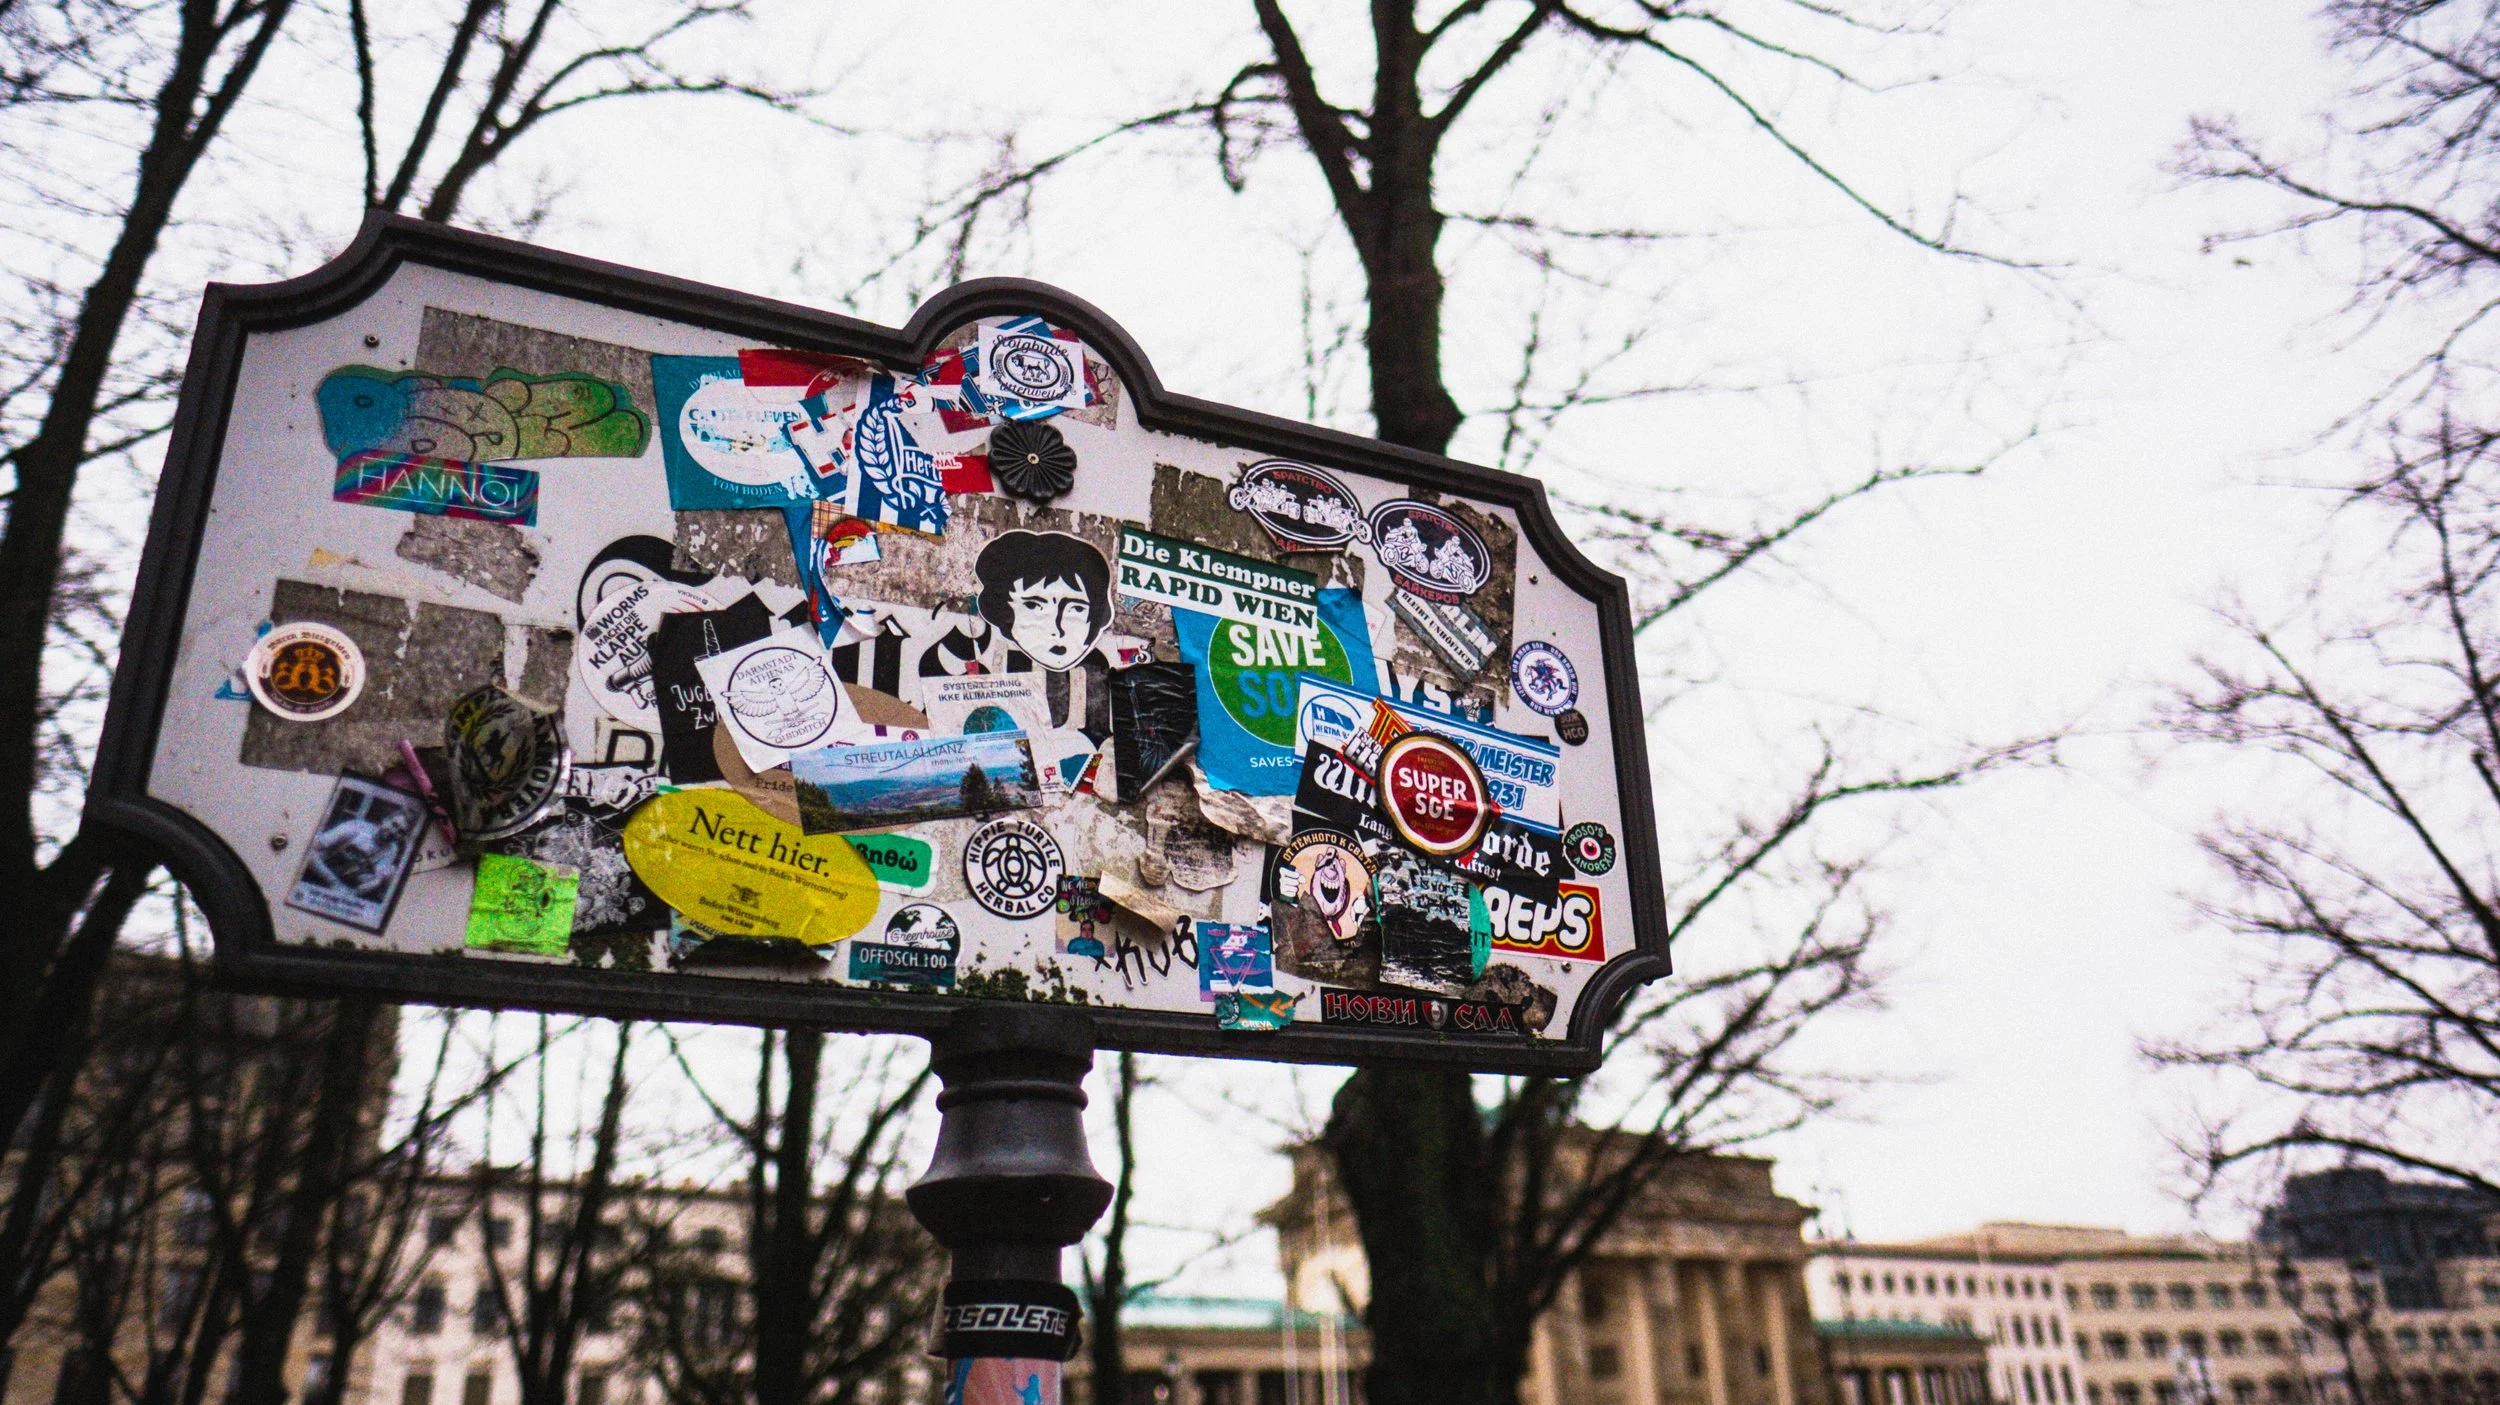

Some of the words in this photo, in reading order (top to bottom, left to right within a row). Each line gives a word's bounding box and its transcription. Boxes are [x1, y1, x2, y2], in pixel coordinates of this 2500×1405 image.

[1122, 534, 1170, 562] Die
[1178, 551, 1316, 600] Klempner
[596, 586, 649, 630] WORMS
[1120, 564, 1223, 606] RAPID
[1233, 591, 1315, 630] WIEN
[589, 618, 648, 670] KLAPPE
[594, 622, 626, 649] MACHT
[624, 610, 640, 625] DIE
[1228, 624, 1326, 667] SAVE
[736, 651, 797, 680] DARMSTADT
[749, 663, 795, 686] ATHENAS
[938, 693, 960, 702] IKKE
[963, 689, 1031, 701] KLIMAENDRING
[775, 720, 827, 744] QUIDDITCH
[845, 742, 966, 766] STREUTALALLIANZ
[1250, 756, 1295, 768] SAVES
[1477, 745, 1555, 787] MEISTER
[1398, 767, 1467, 801] SUPER
[1487, 779, 1526, 810] 931
[1415, 792, 1455, 821] SGE
[687, 806, 764, 854] Nett
[768, 832, 829, 877] hier.
[969, 821, 1006, 863] HIPPIE
[1017, 821, 1060, 868] TURTLE
[1347, 843, 1377, 874] СВЕТЛ
[1573, 847, 1613, 872] ANOREXIA
[976, 882, 1036, 913] HERBAL
[1038, 886, 1054, 904] CO
[891, 927, 954, 943] Greenhouse
[860, 948, 918, 967] OFFOSCH
[1324, 993, 1418, 1026] НОВИ
